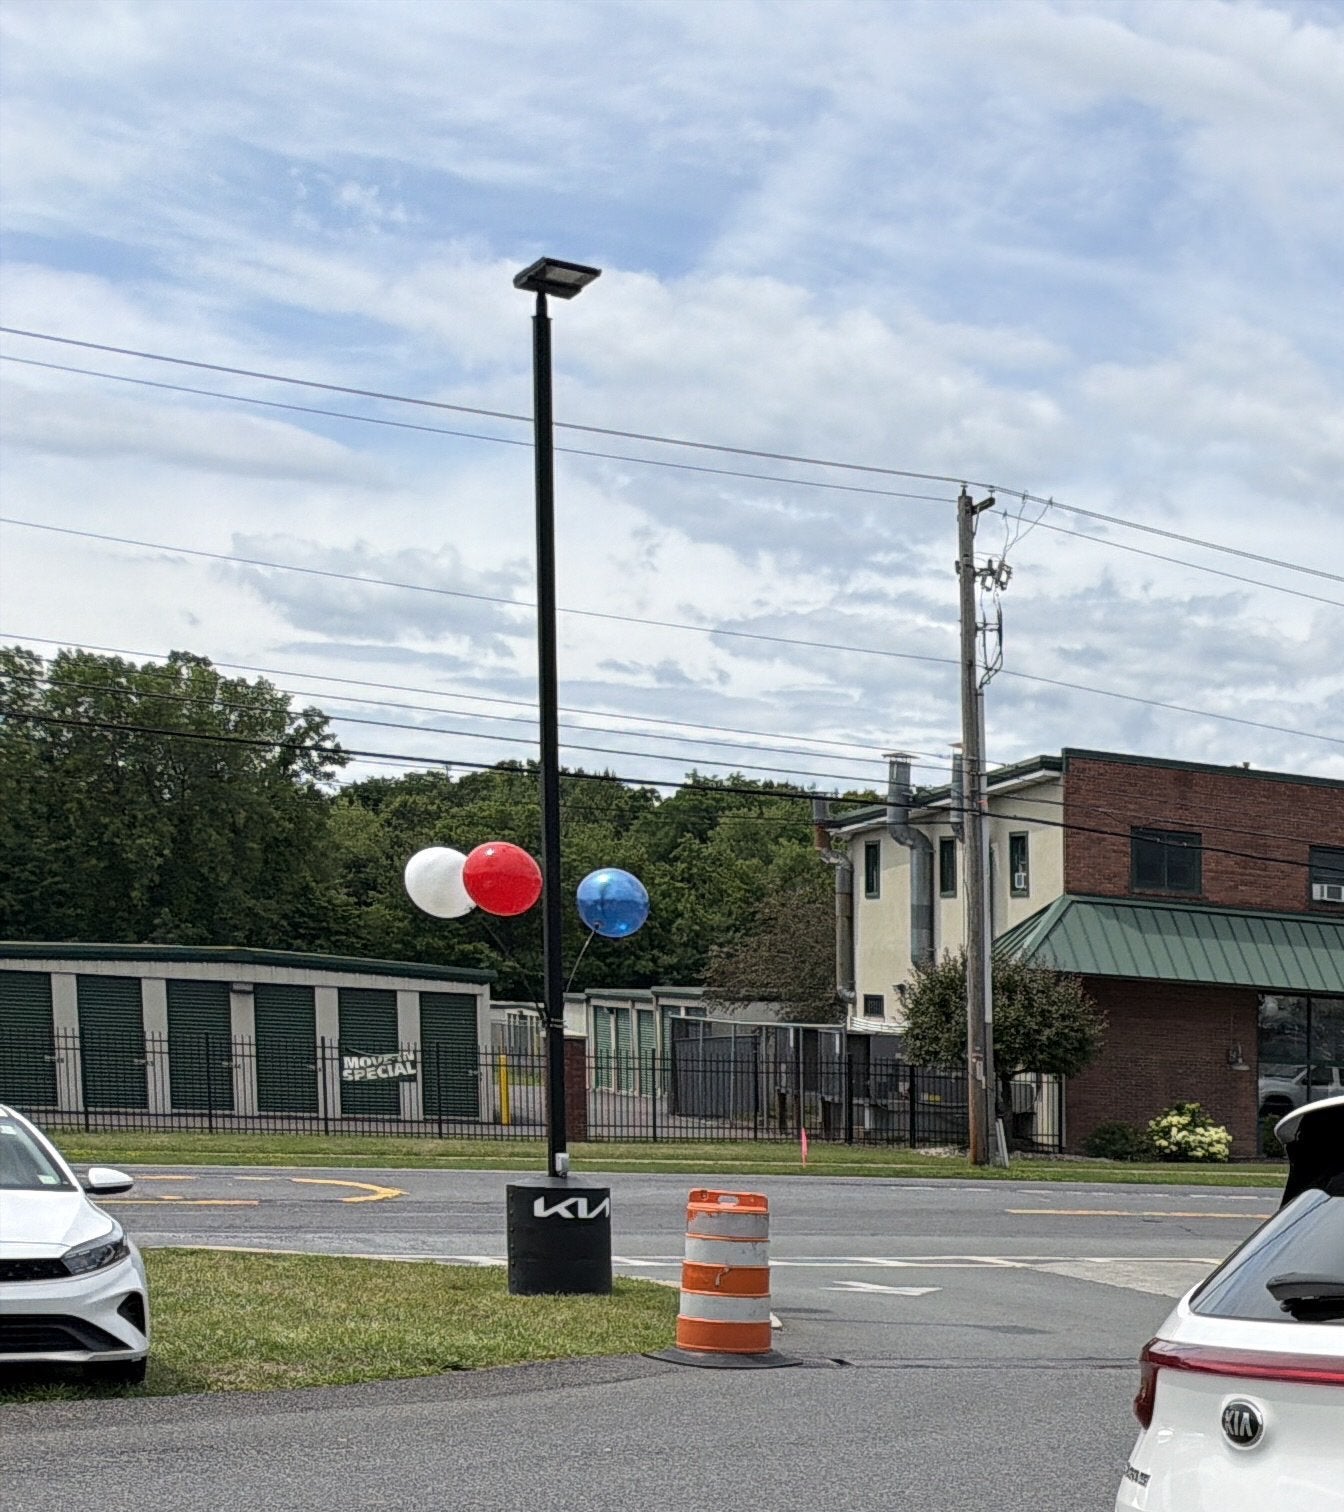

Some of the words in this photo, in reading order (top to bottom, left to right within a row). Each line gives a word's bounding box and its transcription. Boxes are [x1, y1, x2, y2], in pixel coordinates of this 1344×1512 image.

[342, 1062, 416, 1081] SPECIAL
[534, 1196, 610, 1218] KIA
[1224, 1410, 1253, 1436] KIA
